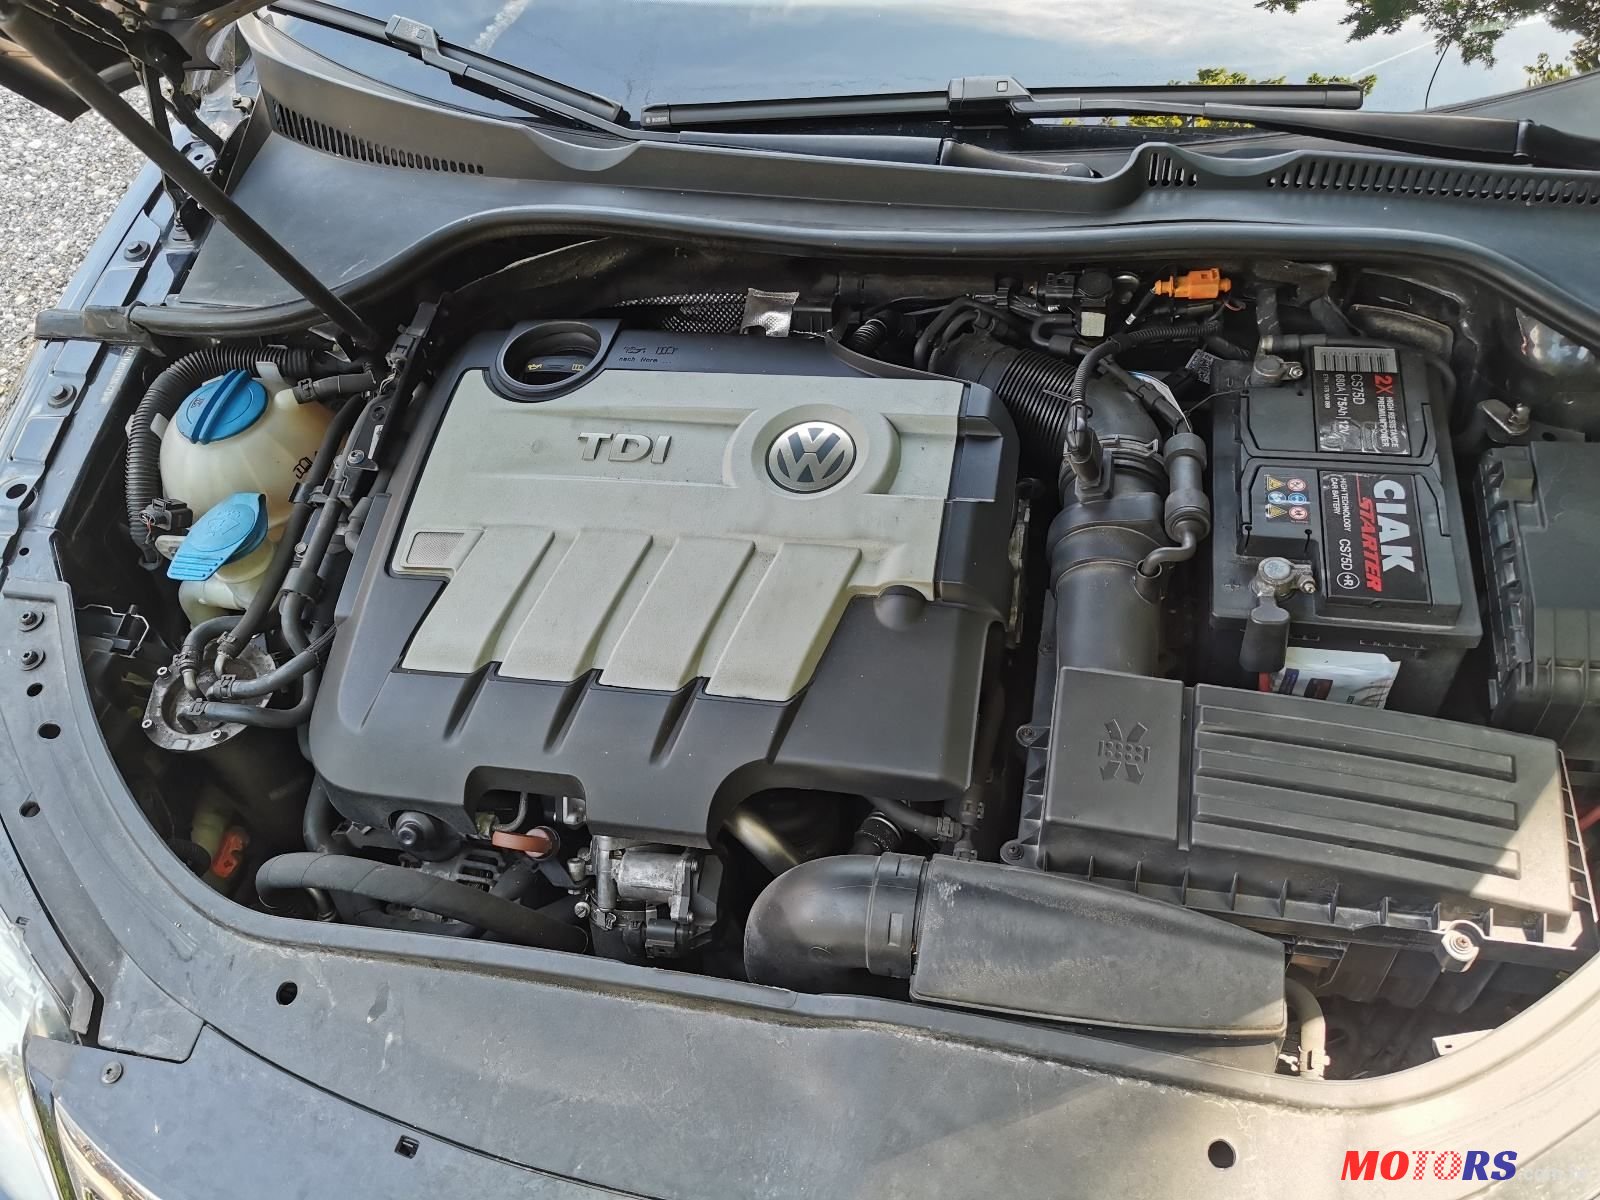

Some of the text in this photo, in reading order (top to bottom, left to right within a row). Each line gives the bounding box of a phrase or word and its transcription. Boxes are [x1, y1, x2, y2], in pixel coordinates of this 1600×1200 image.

[1350, 373, 1366, 405] CS75D
[1375, 374, 1394, 395] 2X
[1337, 396, 1349, 416] 75Ah
[1386, 396, 1399, 448] HIGH RESISTANCE
[1338, 420, 1350, 435] 12V
[578, 432, 672, 465] TDI
[1330, 477, 1341, 515] CAR BATTERY
[1340, 477, 1352, 532] HIGH TECHNOLOGY
[1373, 479, 1415, 573] CIAK
[1339, 538, 1353, 571] CS75D
[1360, 496, 1383, 592] STARTER
